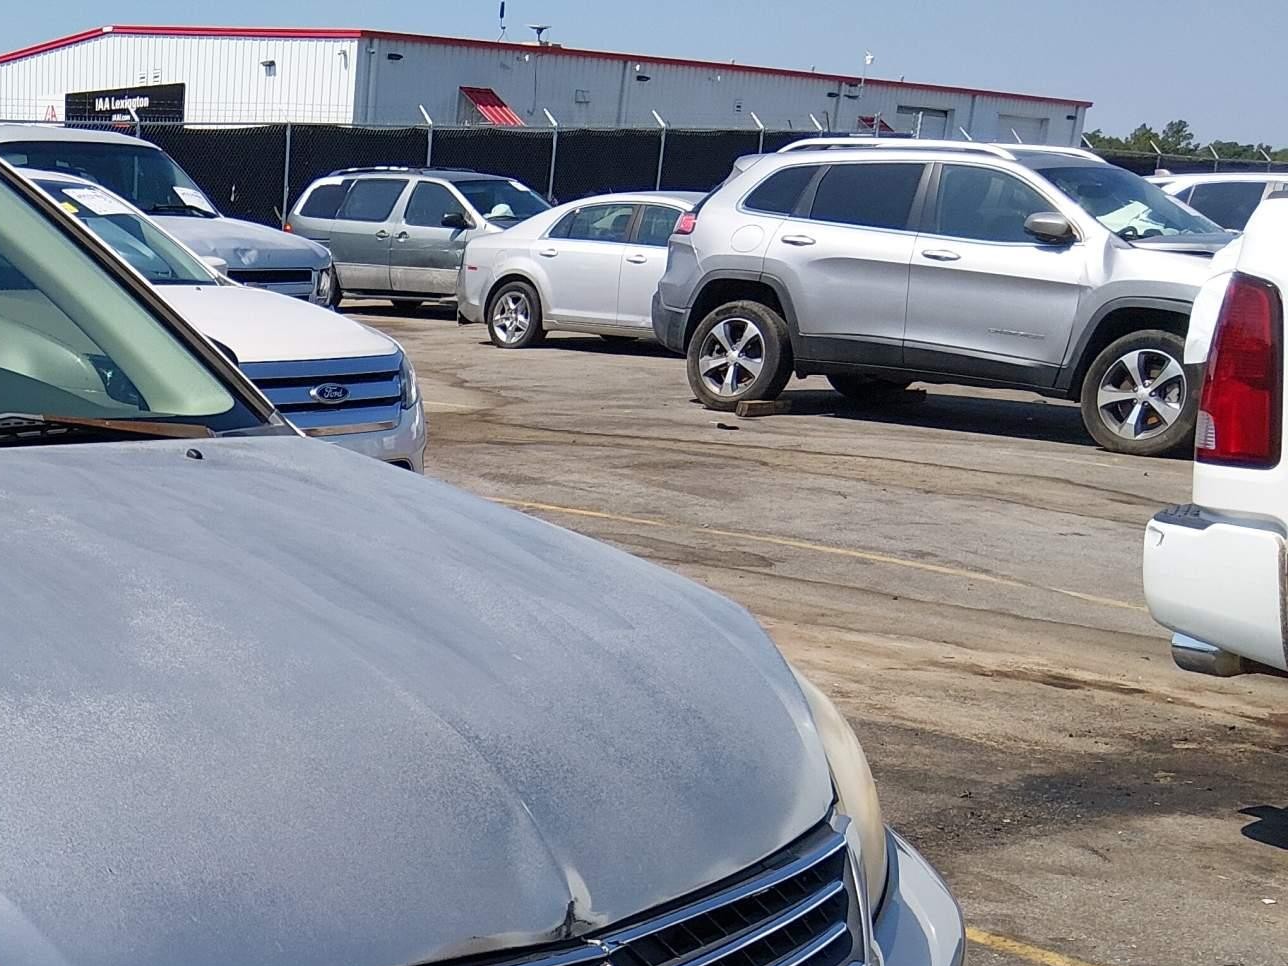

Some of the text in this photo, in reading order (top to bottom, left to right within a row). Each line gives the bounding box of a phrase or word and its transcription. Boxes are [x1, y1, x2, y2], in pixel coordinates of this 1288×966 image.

[95, 96, 149, 112] IAA Lexington
[323, 385, 343, 398] Ford
